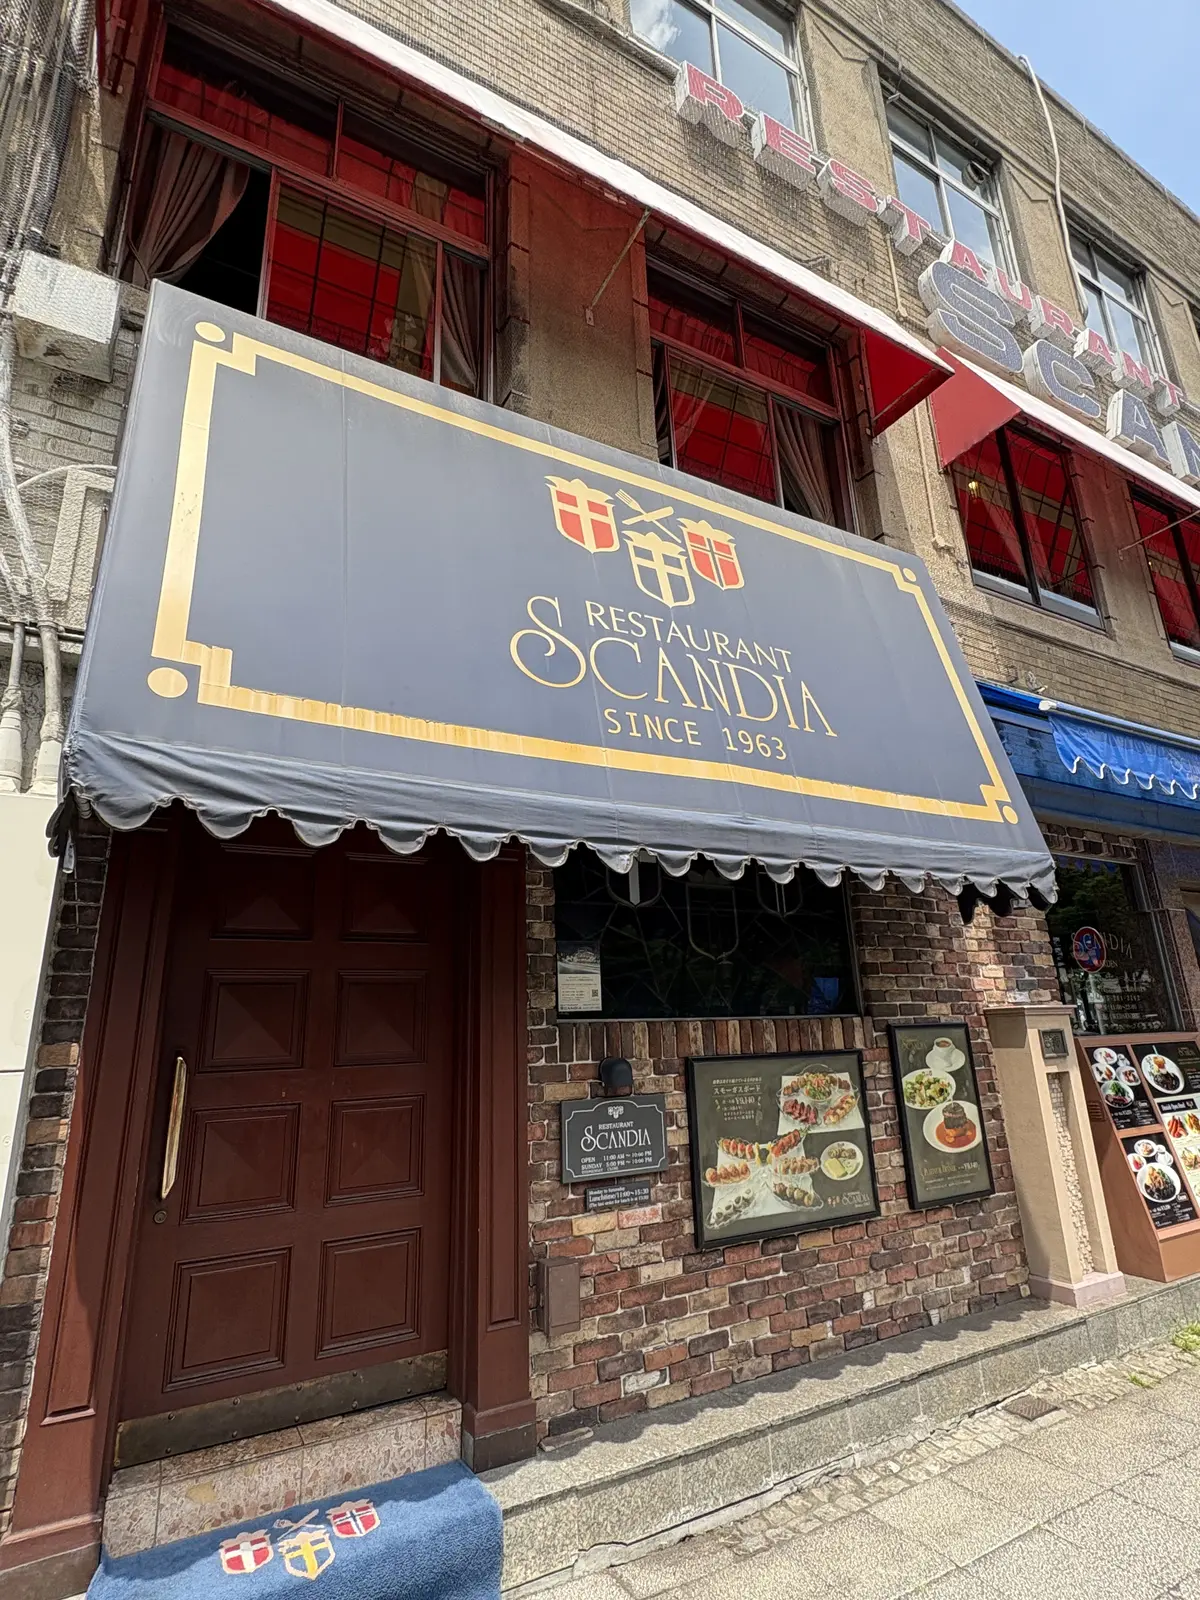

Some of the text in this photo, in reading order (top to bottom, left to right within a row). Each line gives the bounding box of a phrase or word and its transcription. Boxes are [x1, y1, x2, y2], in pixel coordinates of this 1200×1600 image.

[676, 60, 1184, 416] RESTAURANT
[585, 600, 792, 673] RESTAURANT
[510, 595, 838, 737] SCANDIA
[603, 708, 787, 760] SINCE 1963
[580, 1125, 652, 1152] SCANDIA
[598, 1121, 634, 1130] RESTAURANT
[581, 1162, 602, 1170] SUNDAY
